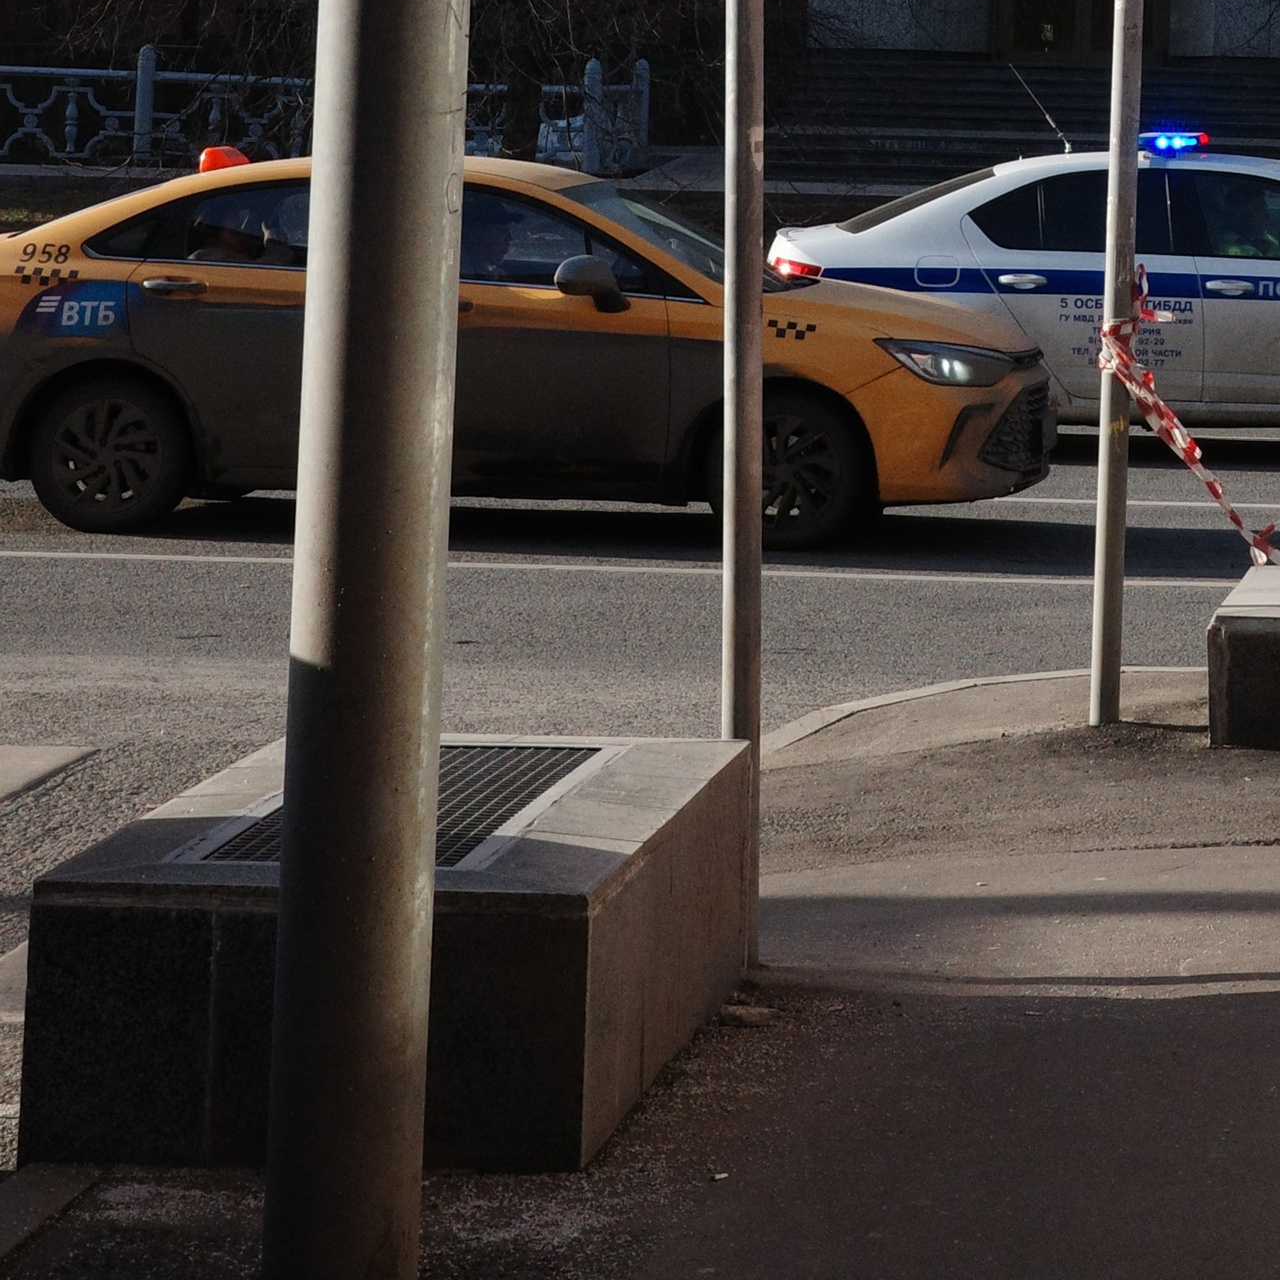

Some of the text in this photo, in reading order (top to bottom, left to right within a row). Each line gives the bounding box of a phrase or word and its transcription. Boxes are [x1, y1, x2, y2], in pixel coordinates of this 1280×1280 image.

[20, 243, 71, 264] 958
[61, 301, 116, 326] ВТБ
[1060, 298, 1069, 309] 5
[1146, 300, 1194, 314] ГИБДД
[1073, 314, 1095, 324] МВД
[1152, 349, 1182, 358] ЧАСТИ
